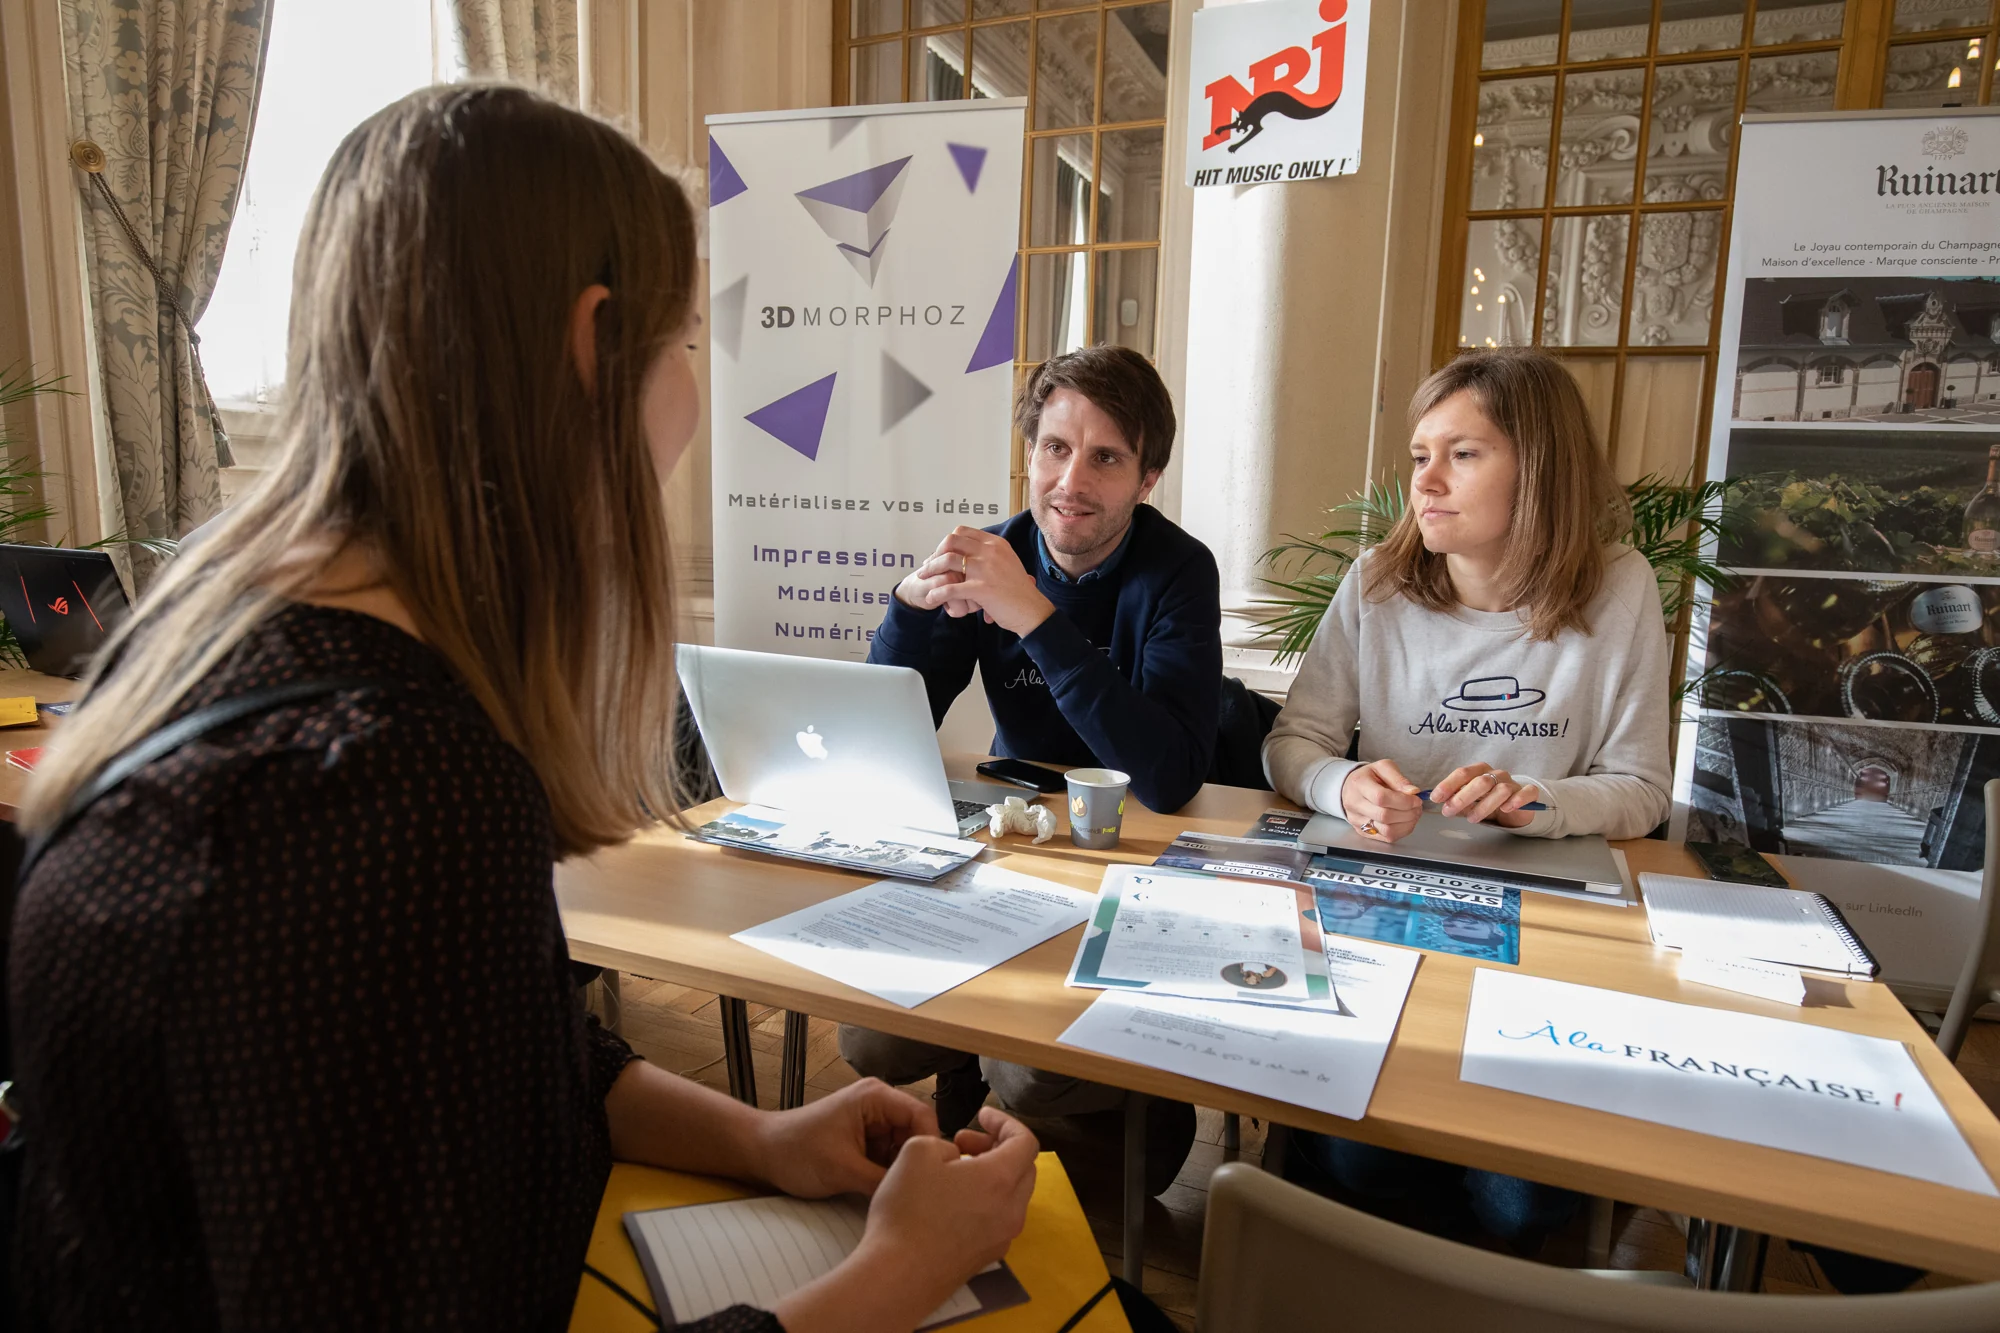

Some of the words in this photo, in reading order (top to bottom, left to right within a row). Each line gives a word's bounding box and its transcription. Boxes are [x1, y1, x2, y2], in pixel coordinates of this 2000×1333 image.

[1193, 168, 1222, 187] HIT
[1225, 163, 1284, 184] MUSIC
[1288, 159, 1336, 180] ONLY
[1918, 207, 1969, 215] CHAMPAGNE
[1793, 242, 1806, 252] Le
[1810, 242, 1841, 253] Joyau
[1844, 241, 1918, 253] contemporain
[1921, 240, 1935, 250] du
[1761, 257, 1798, 267] Maison
[1801, 256, 1866, 267] d'excellence
[1876, 256, 1917, 268] Marque
[1920, 255, 1978, 266] consciente
[728, 493, 871, 512] Matérialisez
[882, 500, 924, 513] vos
[935, 498, 999, 516] idées
[753, 545, 915, 568] Impression
[778, 585, 890, 605] Modélisa
[1926, 602, 1972, 615] Ruinart
[775, 622, 875, 643] Numéris
[1375, 868, 1498, 892] 29.01.2020
[1408, 884, 1499, 906] STAGE
[1845, 902, 1866, 911] sur
[1869, 902, 1923, 917] LinkedIn
[1623, 1045, 1881, 1107] FRANÇAISE
